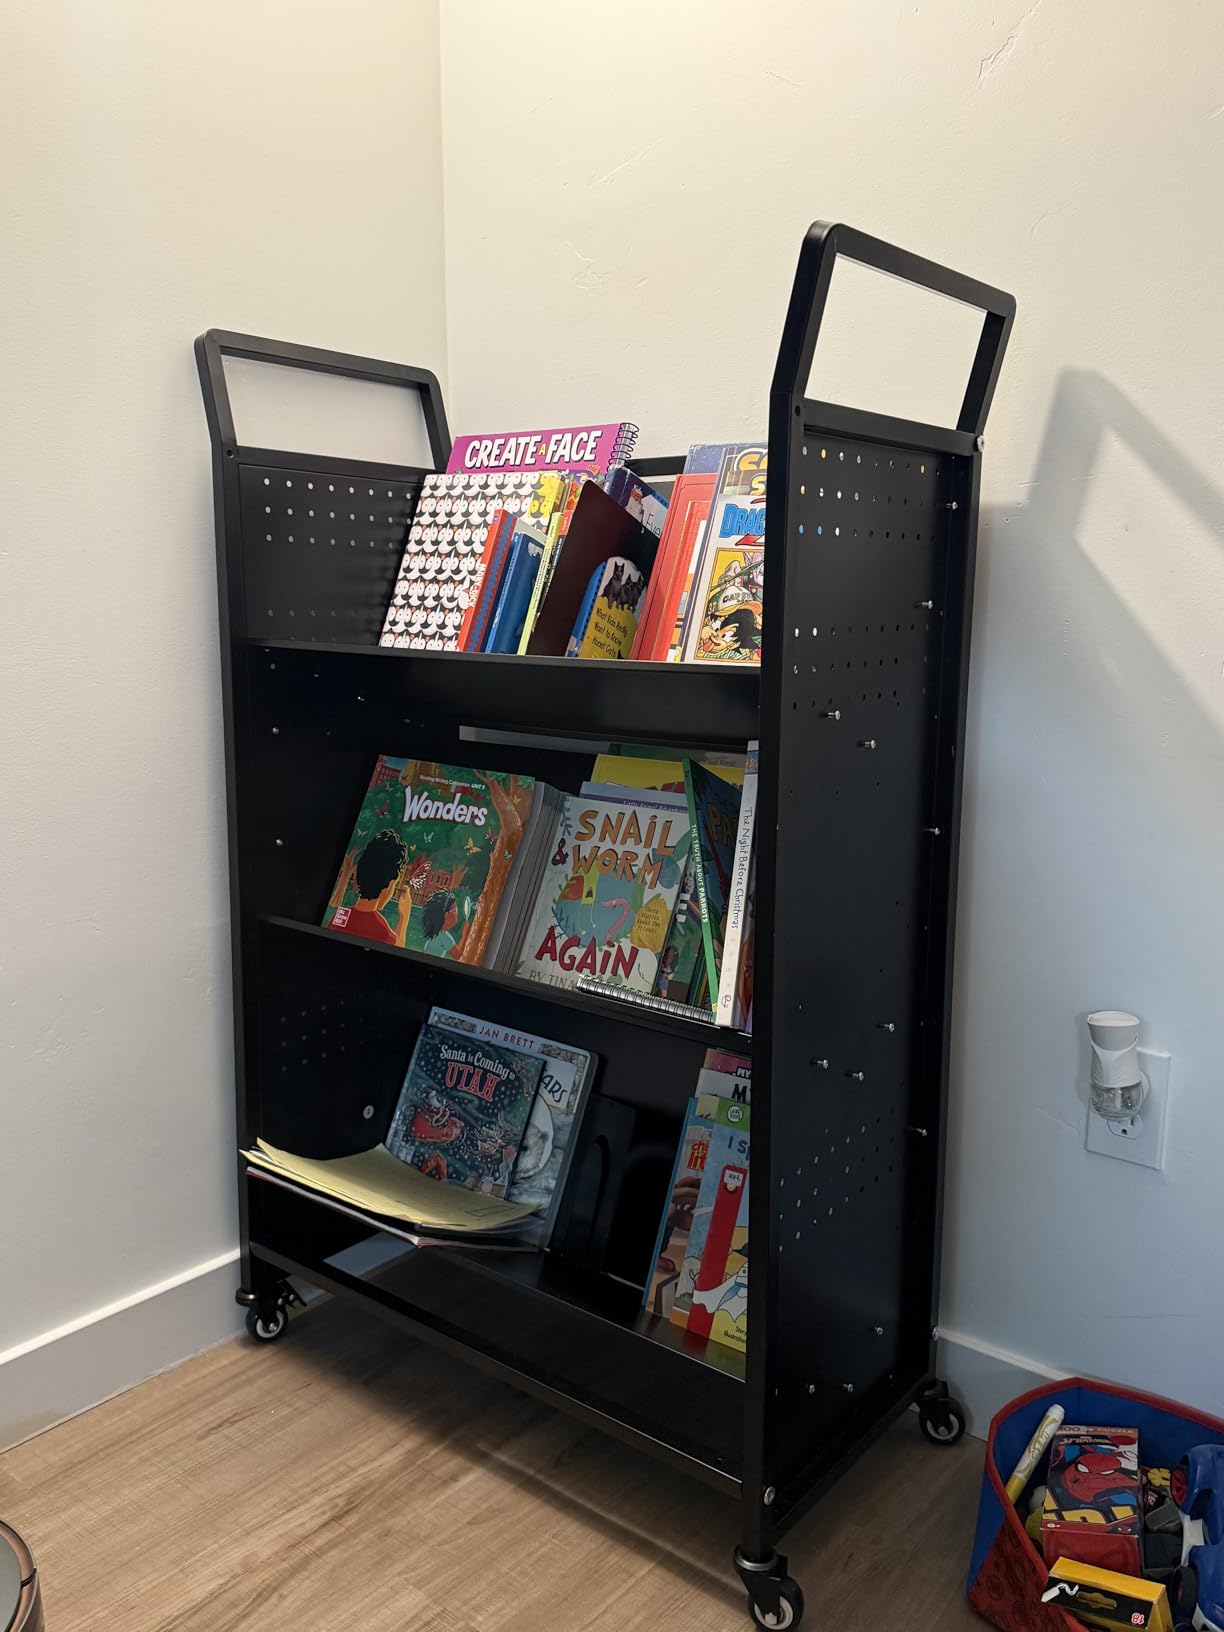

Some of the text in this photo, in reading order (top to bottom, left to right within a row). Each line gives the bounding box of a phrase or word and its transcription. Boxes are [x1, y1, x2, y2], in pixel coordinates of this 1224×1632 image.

[464, 430, 603, 469] CREATE A FACE
[403, 785, 488, 827] Wonders
[551, 838, 663, 889] & WORM
[693, 839, 701, 862] TRUTH
[732, 806, 752, 929] The Night Before Christmas
[696, 863, 704, 885] ABOUT
[699, 886, 709, 922] PARROTS
[479, 1025, 535, 1049] JAN BRETT
[440, 1043, 467, 1062] Santa
[473, 1052, 510, 1080] Coming
[445, 1061, 500, 1103] UTAH
